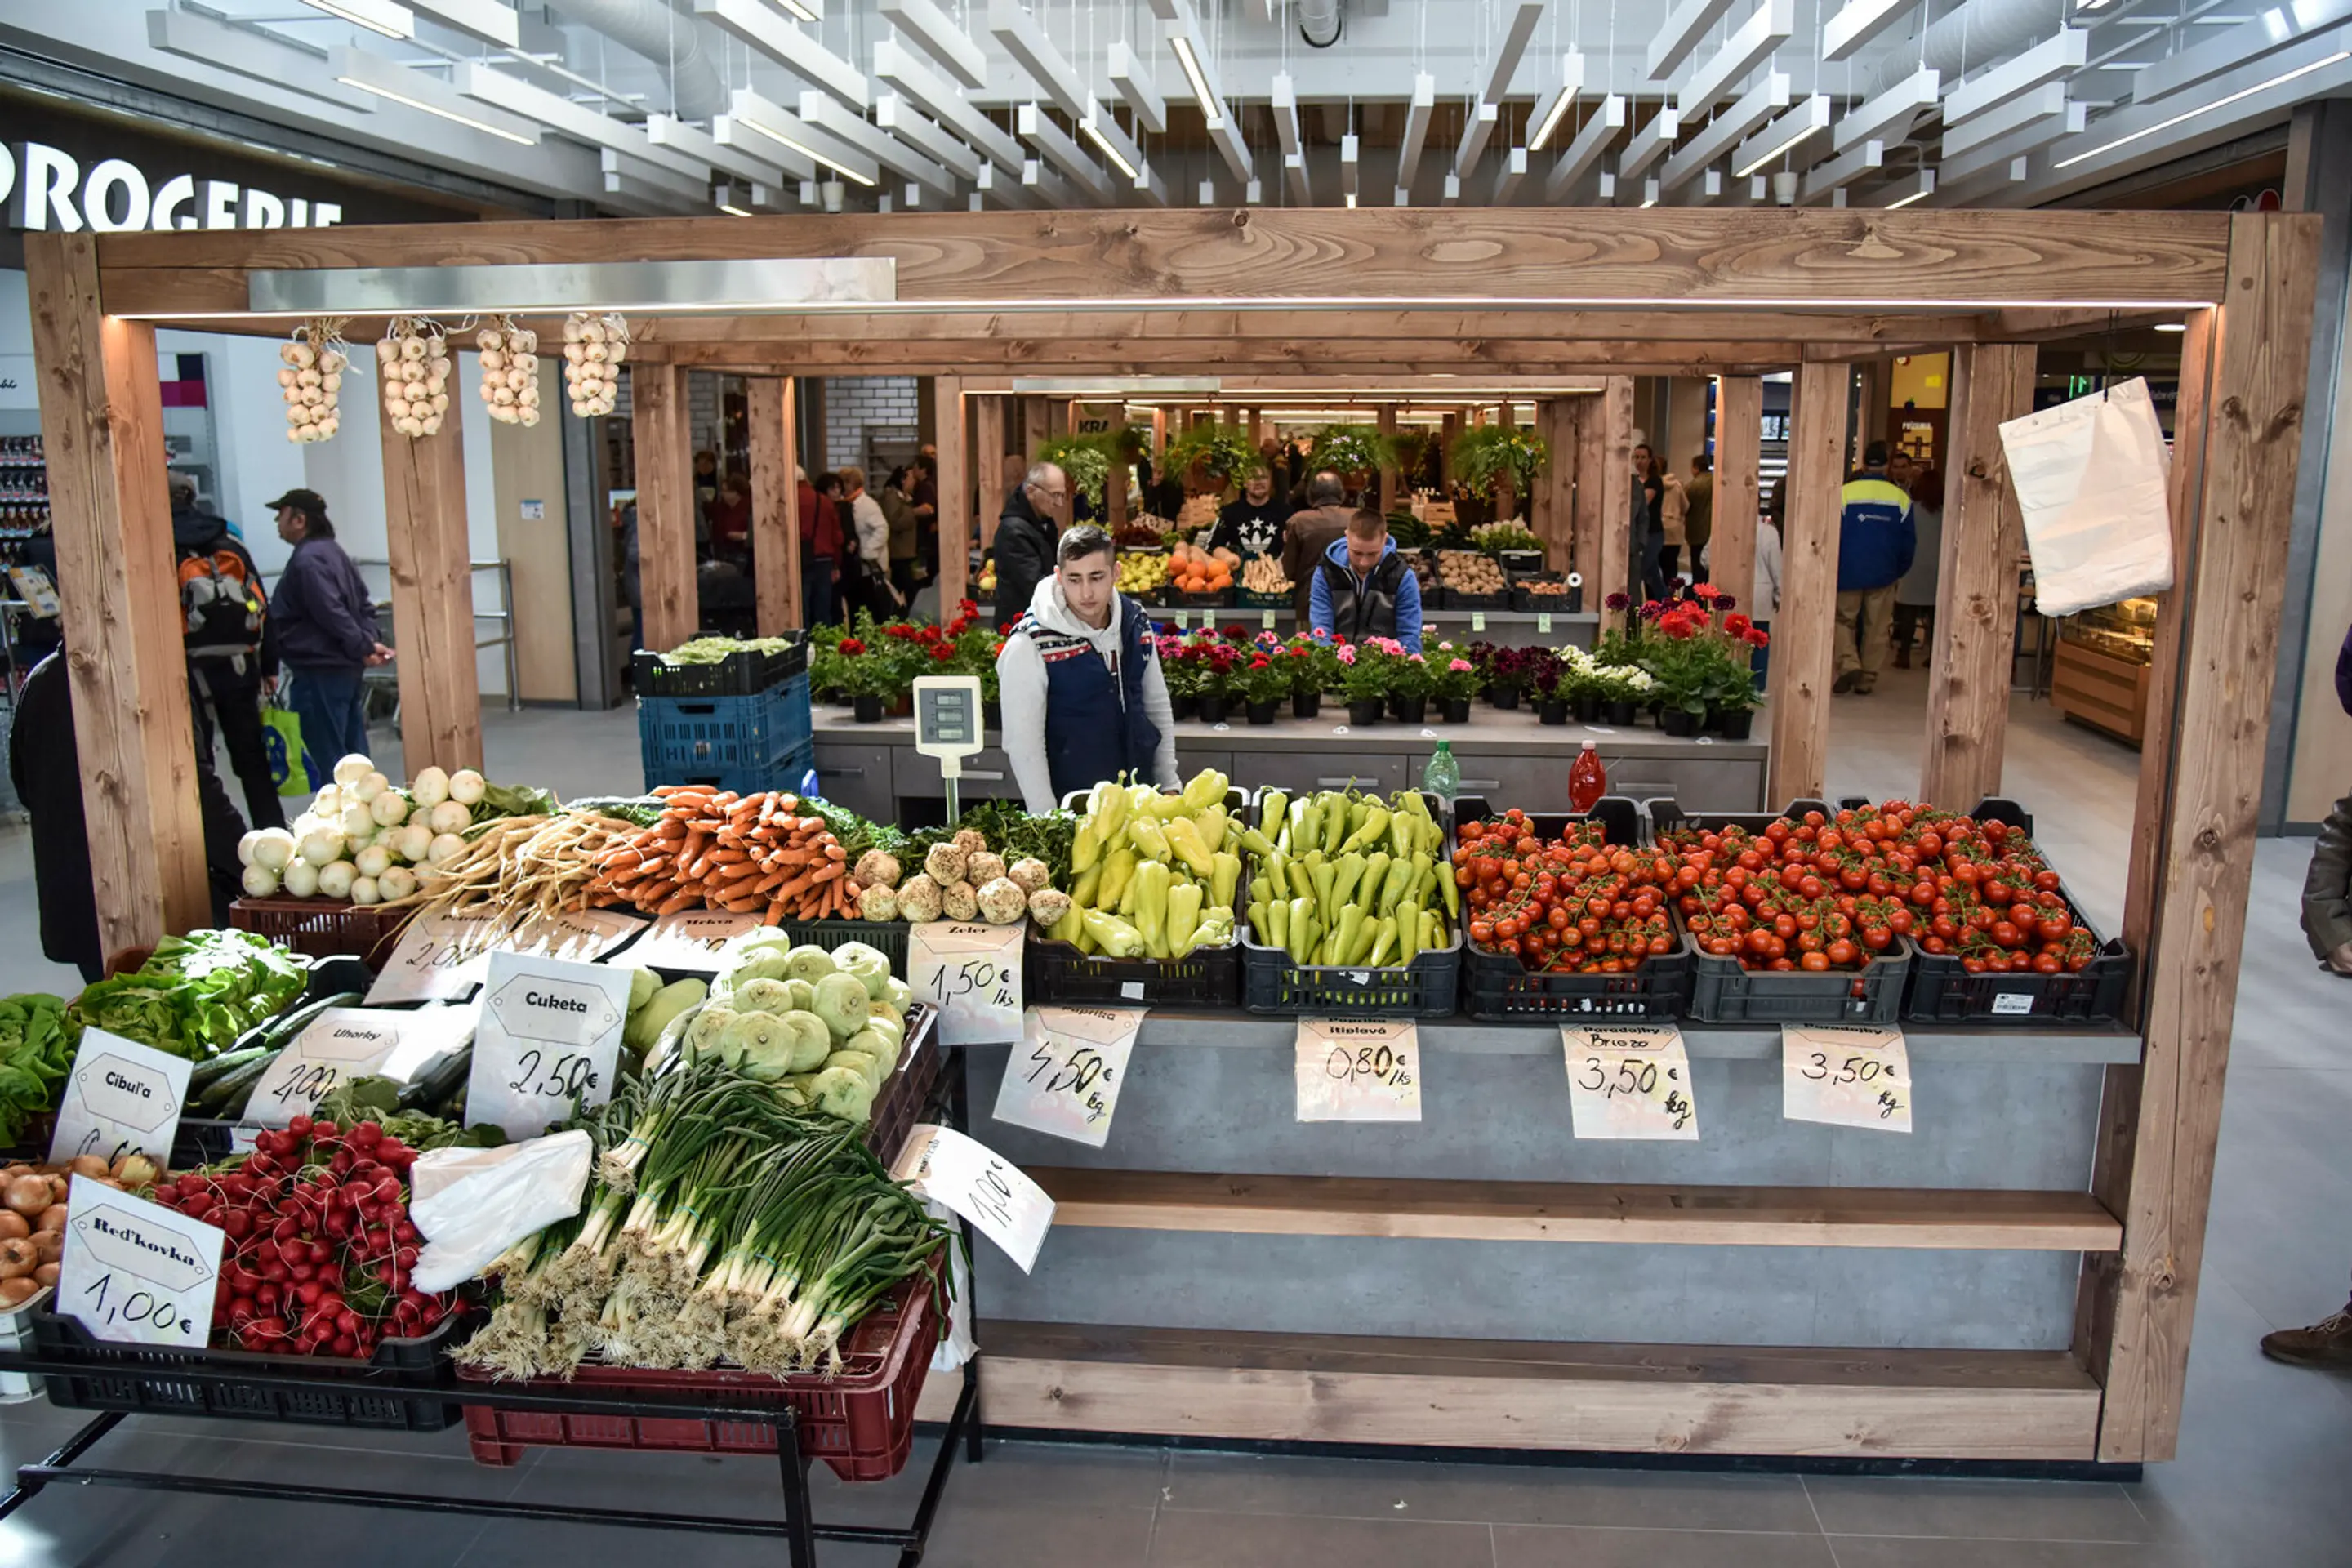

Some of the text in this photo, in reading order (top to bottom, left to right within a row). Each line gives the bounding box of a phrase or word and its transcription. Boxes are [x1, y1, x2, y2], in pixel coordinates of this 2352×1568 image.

[948, 925, 989, 934] Zeler
[525, 991, 587, 1013] Cuketa
[333, 1028, 381, 1040] Uhorky
